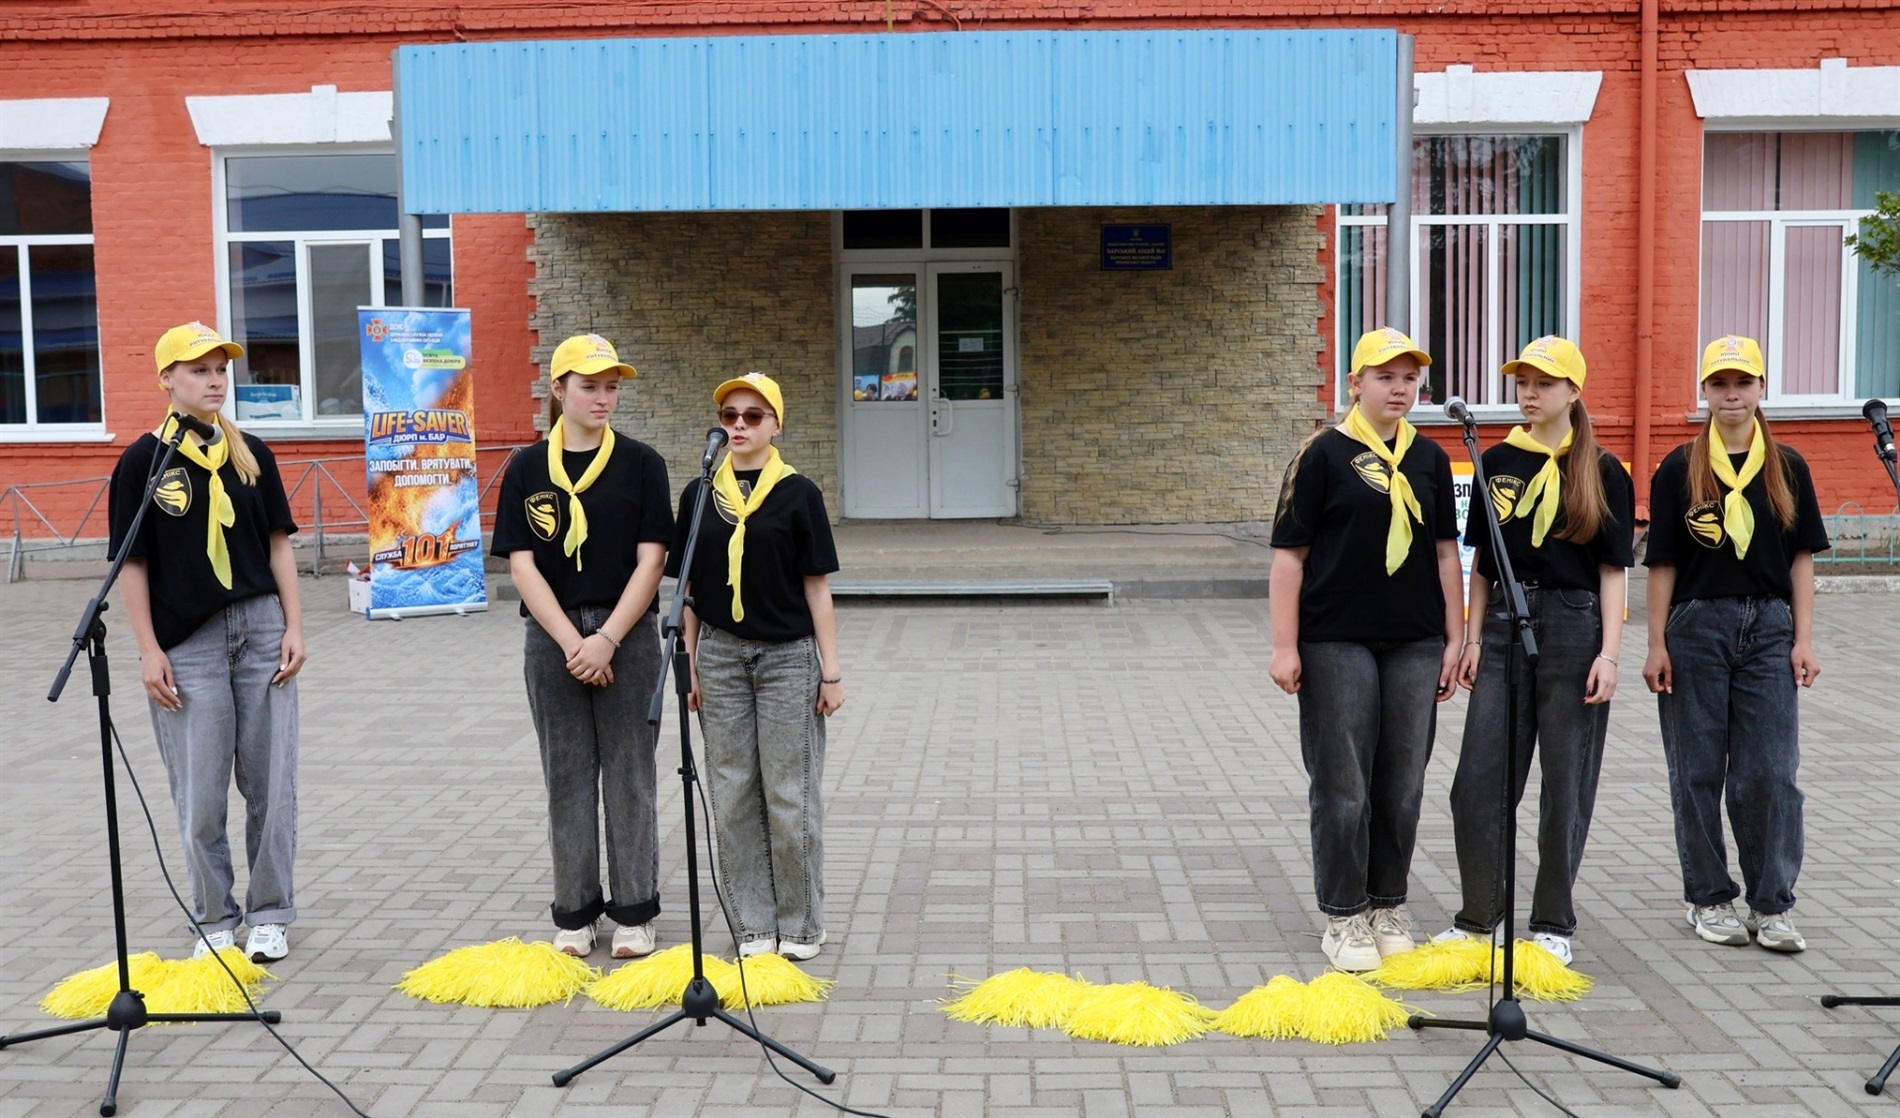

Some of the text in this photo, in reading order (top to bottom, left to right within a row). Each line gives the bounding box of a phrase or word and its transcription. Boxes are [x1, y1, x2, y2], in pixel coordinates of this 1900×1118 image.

[372, 411, 468, 438] LIFE-SAVER
[393, 434, 418, 443] ДЮРП
[428, 433, 445, 441] БАР
[369, 458, 473, 472] ЗАПОБІГТИ. ВРЯТУВАТИ.
[394, 473, 453, 487] ДОПОМОГТИ.
[1494, 477, 1522, 487] ФЕНІКС
[374, 550, 402, 562] СЛУЖБА
[402, 533, 451, 565] 101
